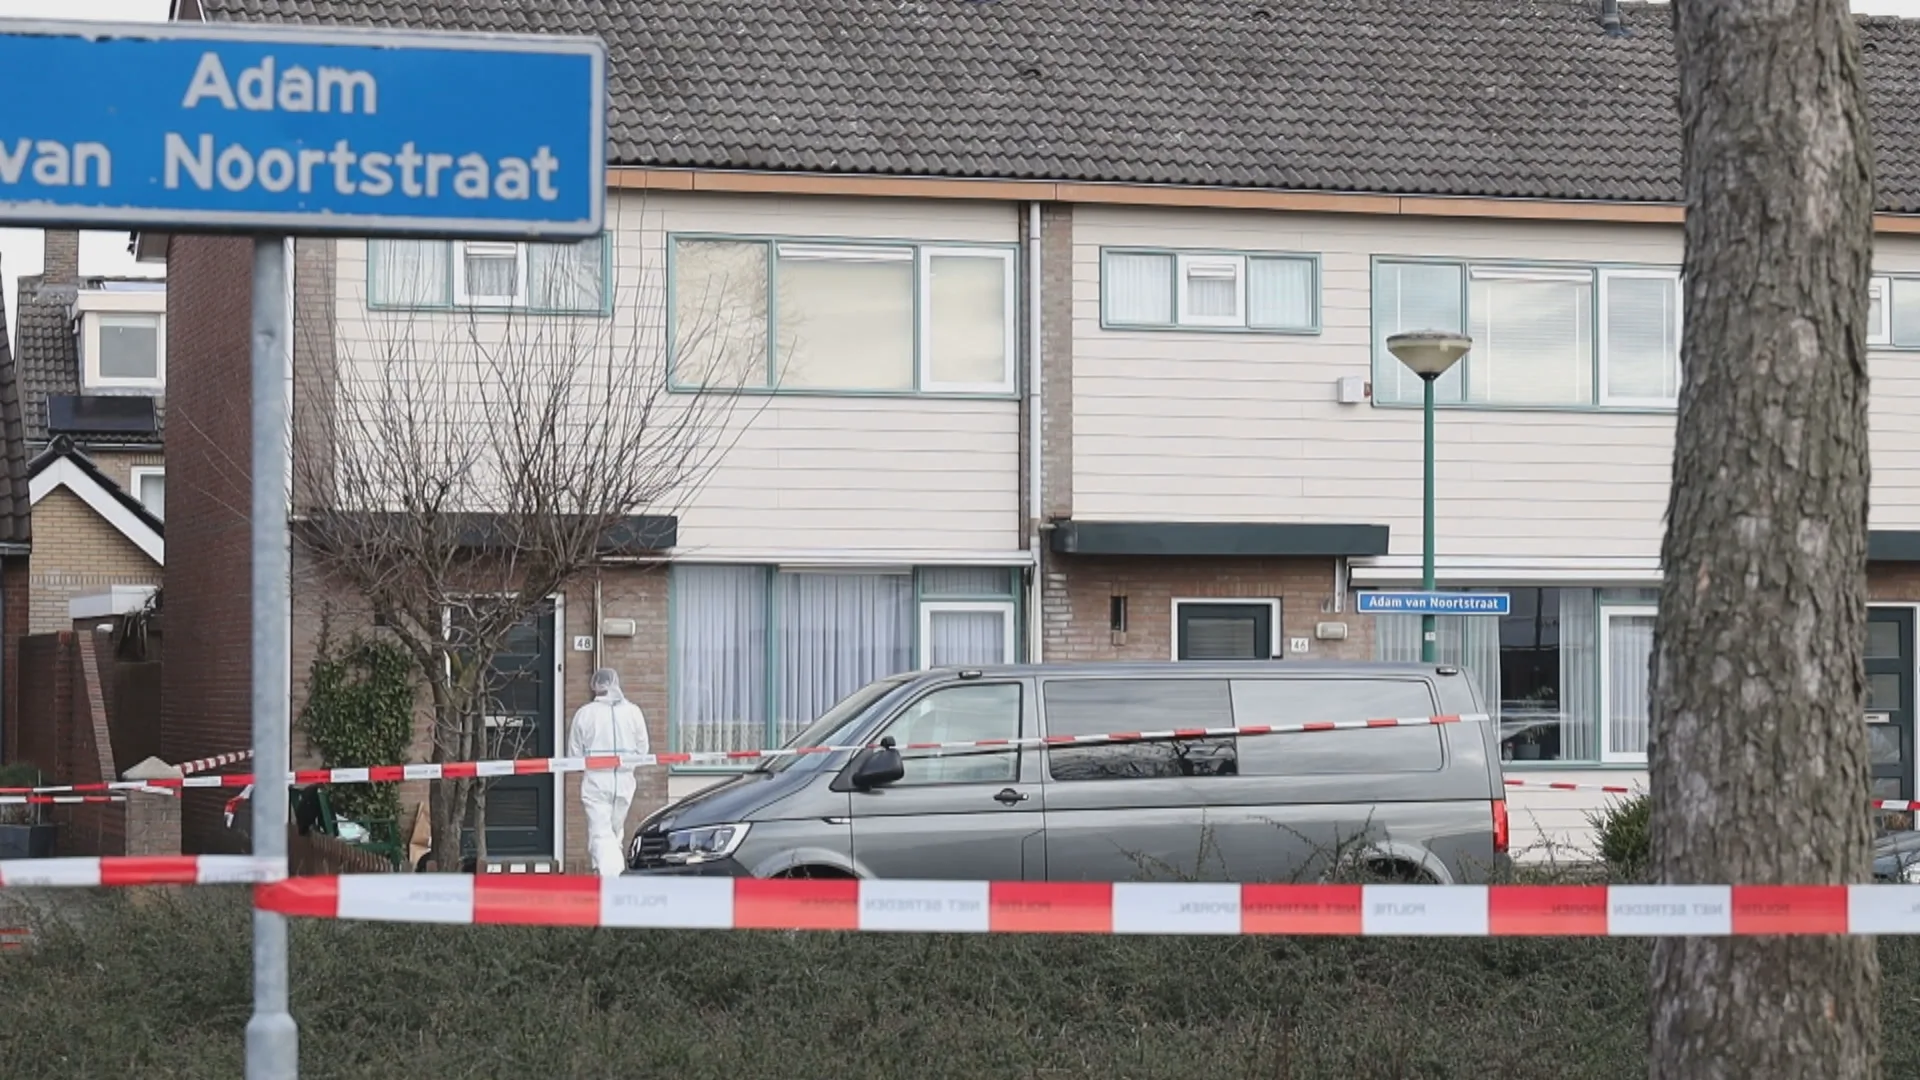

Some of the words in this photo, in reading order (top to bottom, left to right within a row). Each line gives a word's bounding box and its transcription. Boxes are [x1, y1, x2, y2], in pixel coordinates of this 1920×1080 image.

[182, 52, 377, 114] Adam
[0, 138, 111, 187] van
[164, 133, 558, 200] Noortstraat
[1369, 596, 1402, 607] Adam
[1405, 598, 1426, 608] van
[1430, 597, 1498, 609] Noortstraat
[577, 638, 591, 649] 48
[1293, 639, 1306, 652] 46
